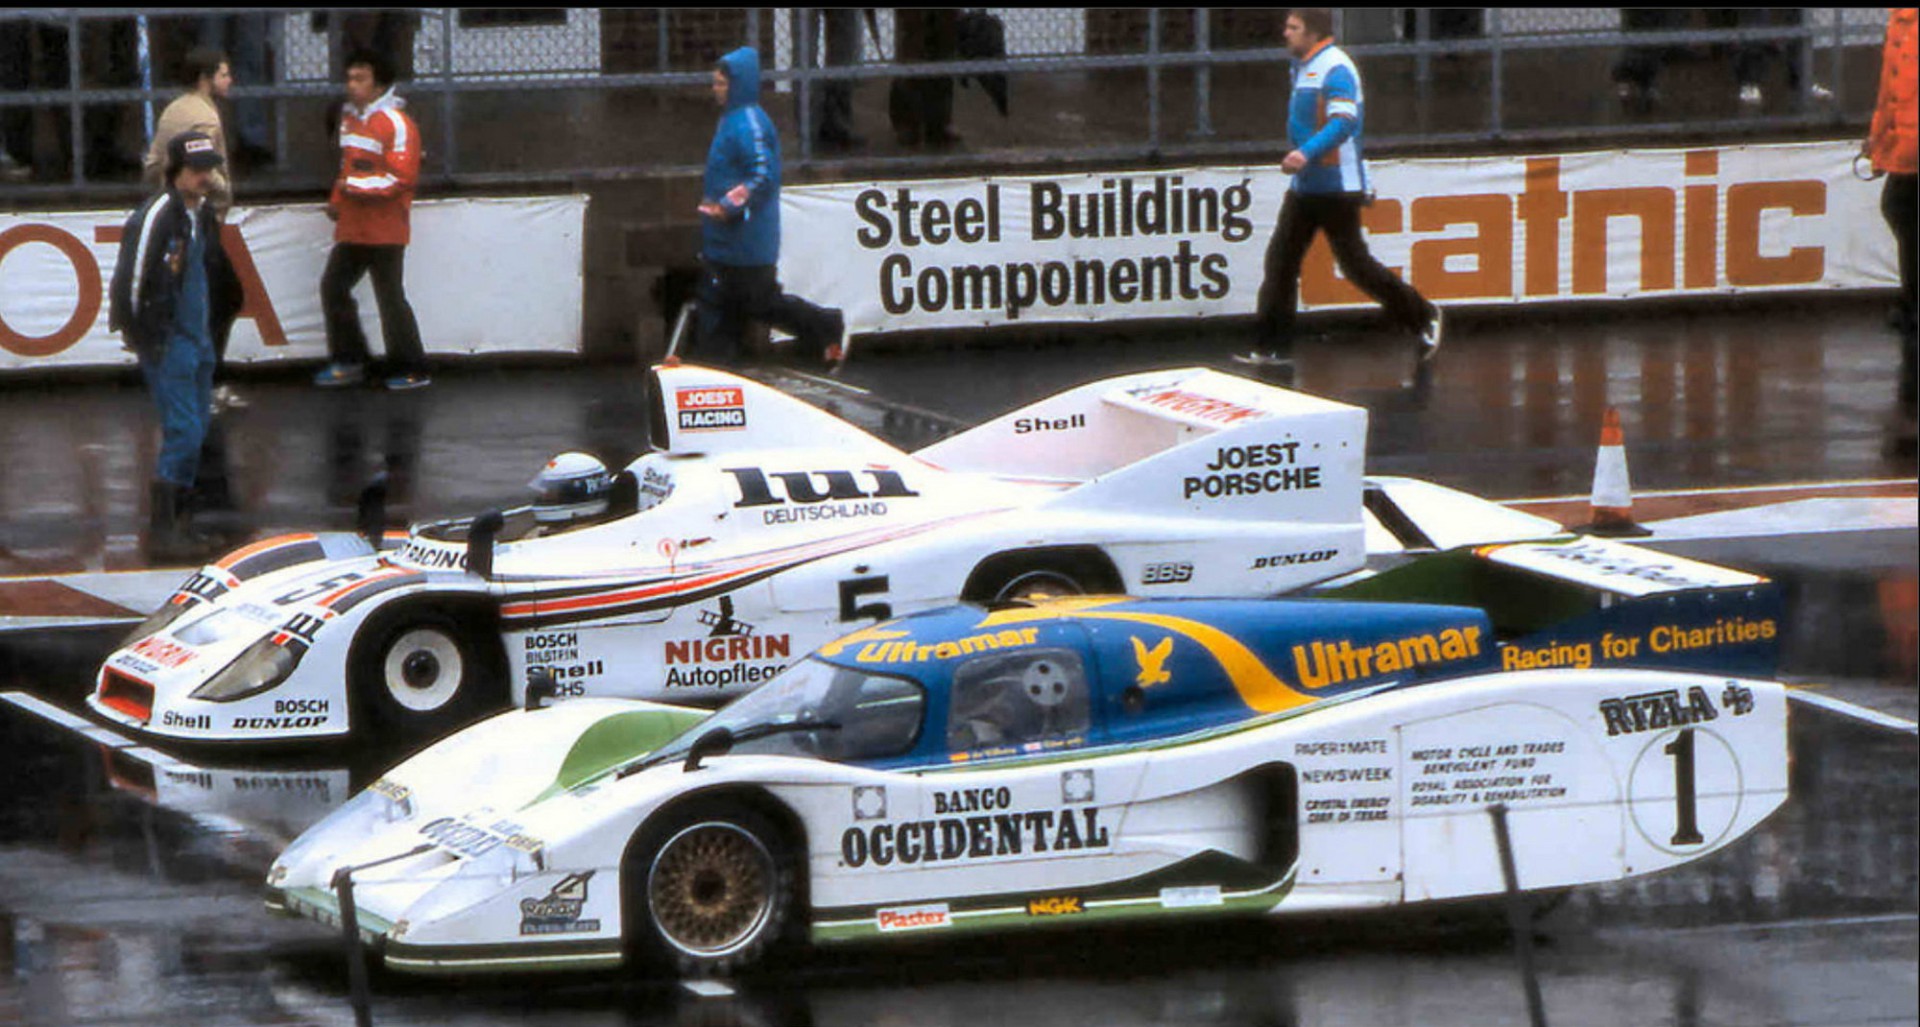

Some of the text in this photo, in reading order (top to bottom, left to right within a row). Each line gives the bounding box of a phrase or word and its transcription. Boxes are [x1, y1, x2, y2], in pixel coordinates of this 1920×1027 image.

[855, 176, 1253, 249] Steel Building
[0, 223, 289, 357] OA
[880, 240, 1230, 320] Components
[685, 391, 737, 406] JOEST
[681, 411, 743, 427] RACING
[1014, 413, 1086, 434] Shell
[1206, 442, 1300, 471] JOEST
[721, 467, 920, 508] lui
[1184, 466, 1321, 500] PORSCHE
[763, 502, 888, 525] DEUTSCHLAND
[1252, 549, 1338, 569] DUNLOP
[1141, 562, 1195, 585] BBS
[525, 633, 578, 650] BOSCH
[665, 633, 790, 665] NIGRIN
[856, 627, 1039, 663] Ultramar
[1502, 617, 1776, 670] Racing for Charities
[1292, 625, 1481, 690] Ultramar
[275, 700, 329, 714] BOSCH
[1599, 685, 1719, 736] RIZLA
[163, 710, 211, 729] Shell
[232, 716, 328, 729] DUNLOP
[1411, 742, 1565, 760] MOTOR CYCLE AND TRADES
[1302, 767, 1392, 783] NEWSWEEK
[1423, 757, 1536, 774] BENEVOLENT FUND
[1453, 776, 1525, 789] ASSOCIATION
[1664, 728, 1704, 845] 1
[934, 786, 1011, 814] BANCO
[1484, 788, 1566, 802] REHABILITATION
[842, 807, 1109, 868] OCCIDENTAL
[1029, 897, 1083, 915] NGK
